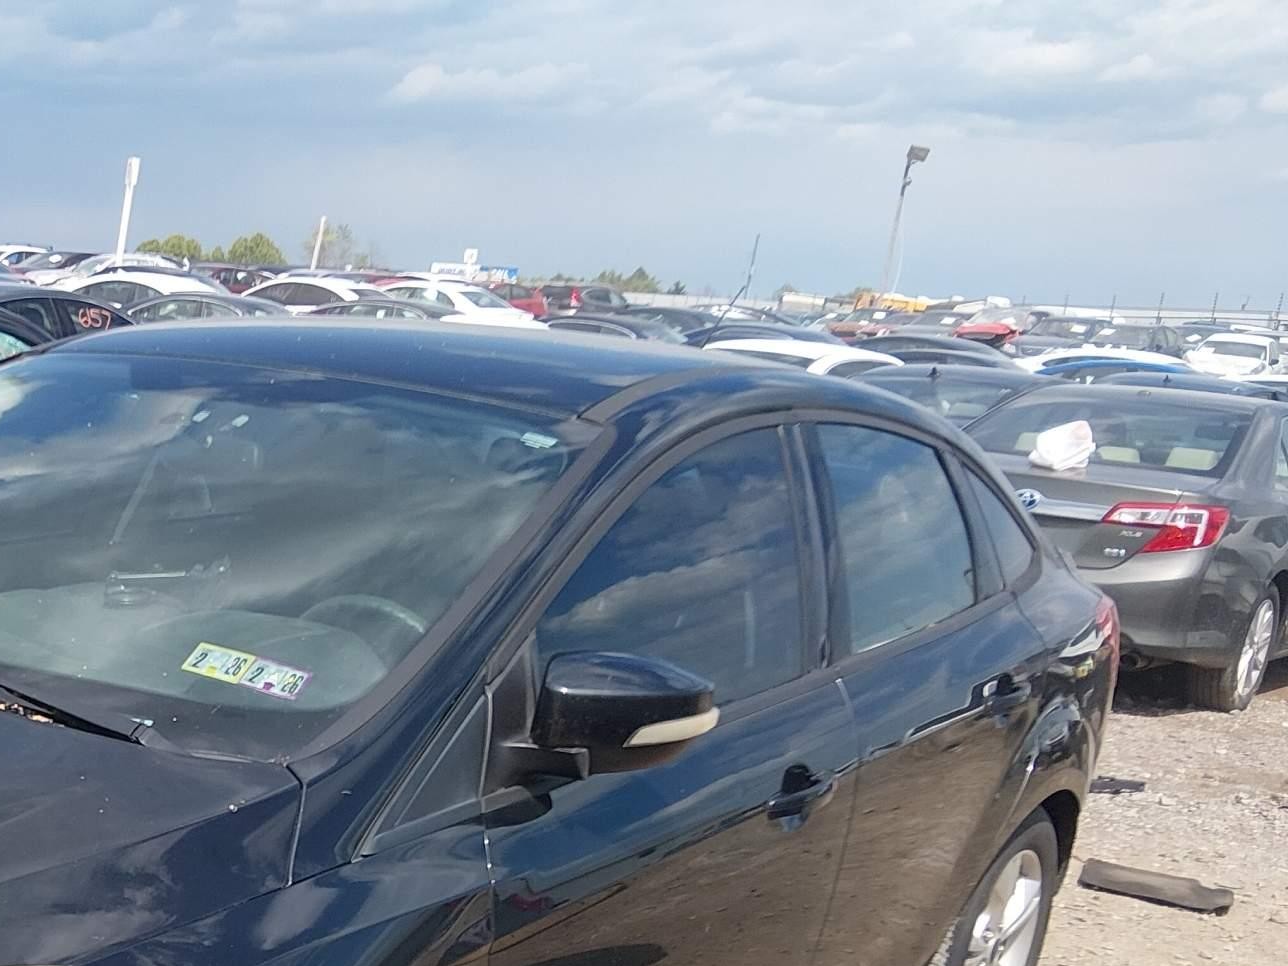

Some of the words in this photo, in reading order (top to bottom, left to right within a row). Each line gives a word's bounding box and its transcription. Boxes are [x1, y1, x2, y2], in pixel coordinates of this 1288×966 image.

[192, 652, 208, 668] 2
[224, 657, 247, 676] 26
[250, 667, 265, 683] 2
